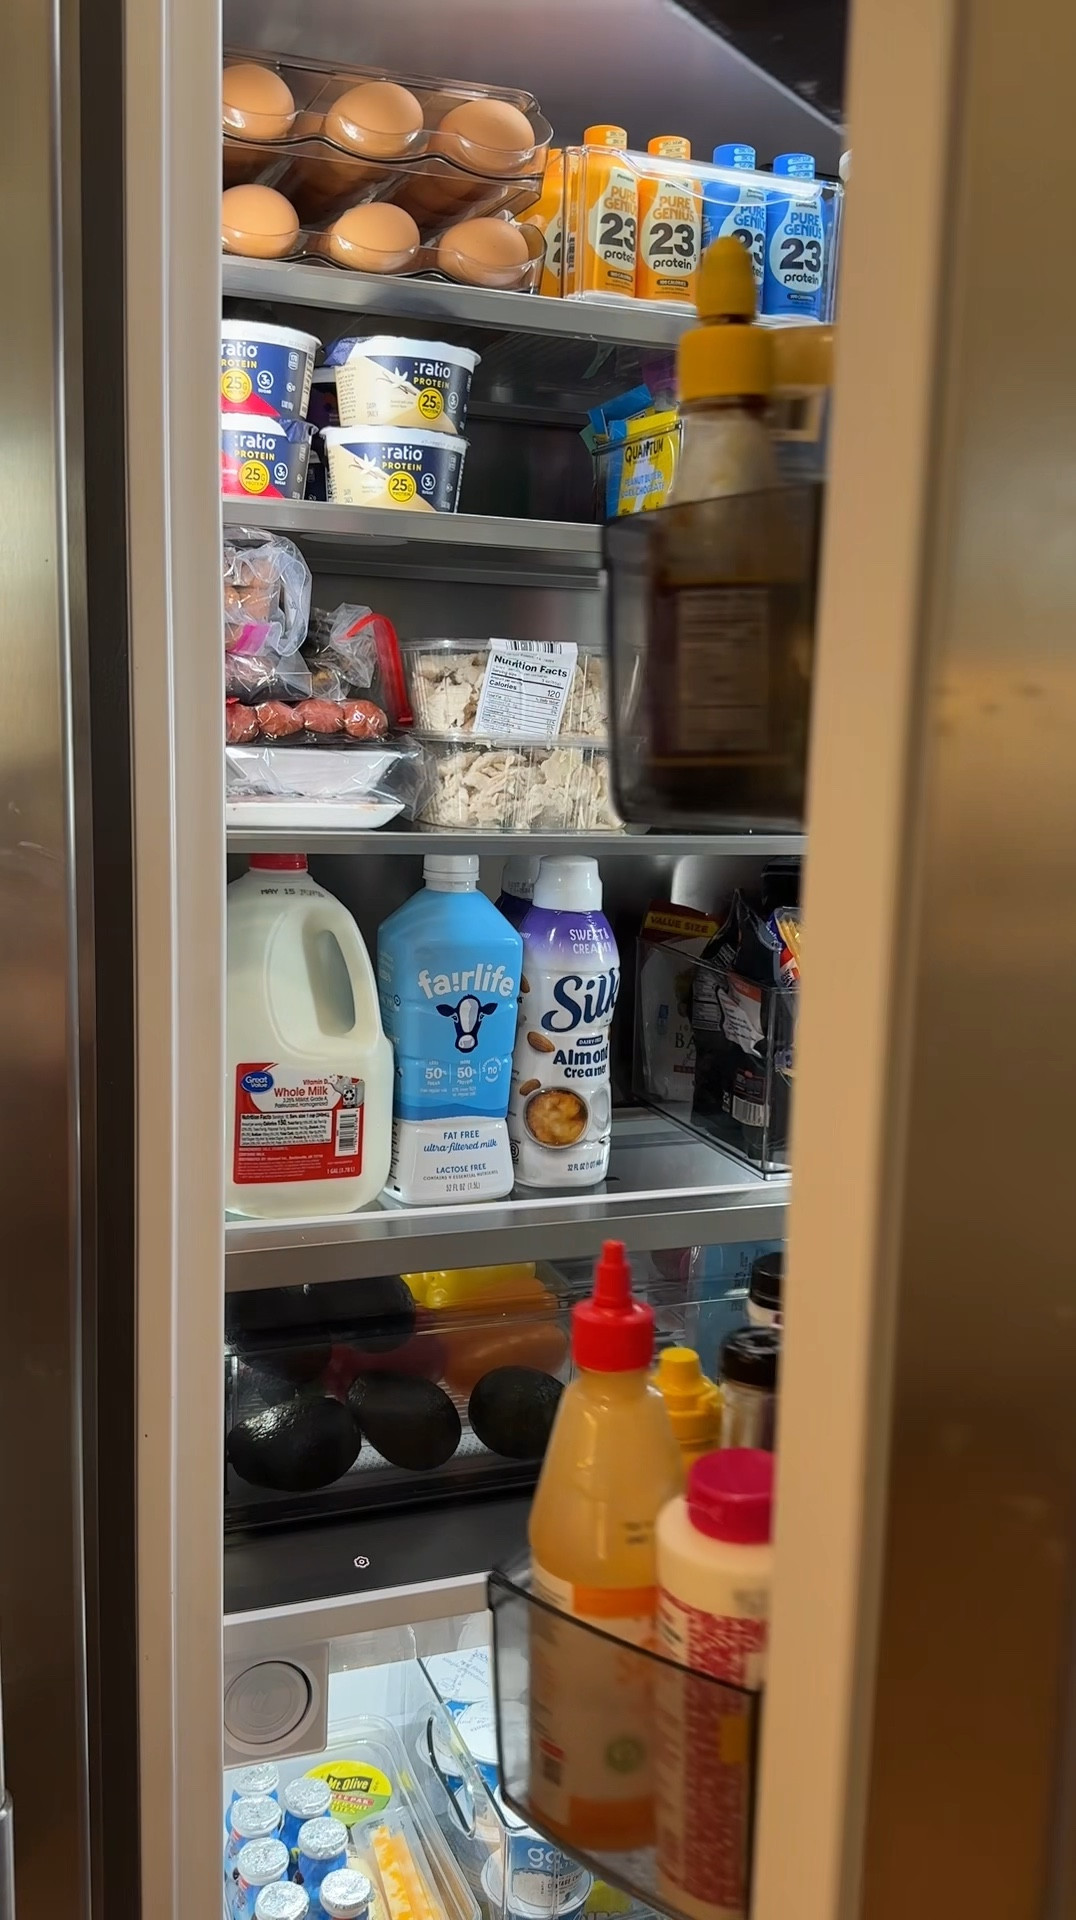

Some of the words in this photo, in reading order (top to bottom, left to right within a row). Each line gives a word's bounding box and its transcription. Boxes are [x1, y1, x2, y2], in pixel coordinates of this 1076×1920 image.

[604, 197, 637, 216] GENIU
[660, 196, 691, 210] PURE
[653, 207, 695, 223] GENIUS
[791, 212, 820, 226] PURE
[600, 212, 636, 252] 23
[784, 224, 821, 239] GENIUS
[649, 222, 694, 257] 23
[780, 238, 821, 273] 23
[653, 258, 692, 270] protein
[784, 273, 819, 286] protein
[413, 376, 450, 389] PROTEIN
[234, 450, 275, 461] PROTEIN
[625, 438, 664, 465] QUANTUM
[382, 462, 422, 472] PROTEIN
[494, 655, 538, 673] Nutrition
[540, 665, 568, 678] Facts
[489, 679, 517, 691] Calories
[547, 690, 561, 699] 120
[651, 915, 682, 929] VALUE
[684, 922, 710, 934] SIZE
[541, 968, 619, 1033] Silk
[487, 1067, 498, 1075] no
[245, 1075, 268, 1084] Great
[274, 1087, 305, 1098] Whole
[308, 1086, 328, 1097] Milk
[443, 1131, 458, 1140] FAT
[460, 1129, 480, 1139] FREE
[423, 1141, 479, 1154] ultra-filtered
[480, 1138, 498, 1149] milk
[436, 1165, 469, 1174] LACTOSE
[470, 1163, 487, 1171] FREE
[342, 1777, 369, 1791] Olive
